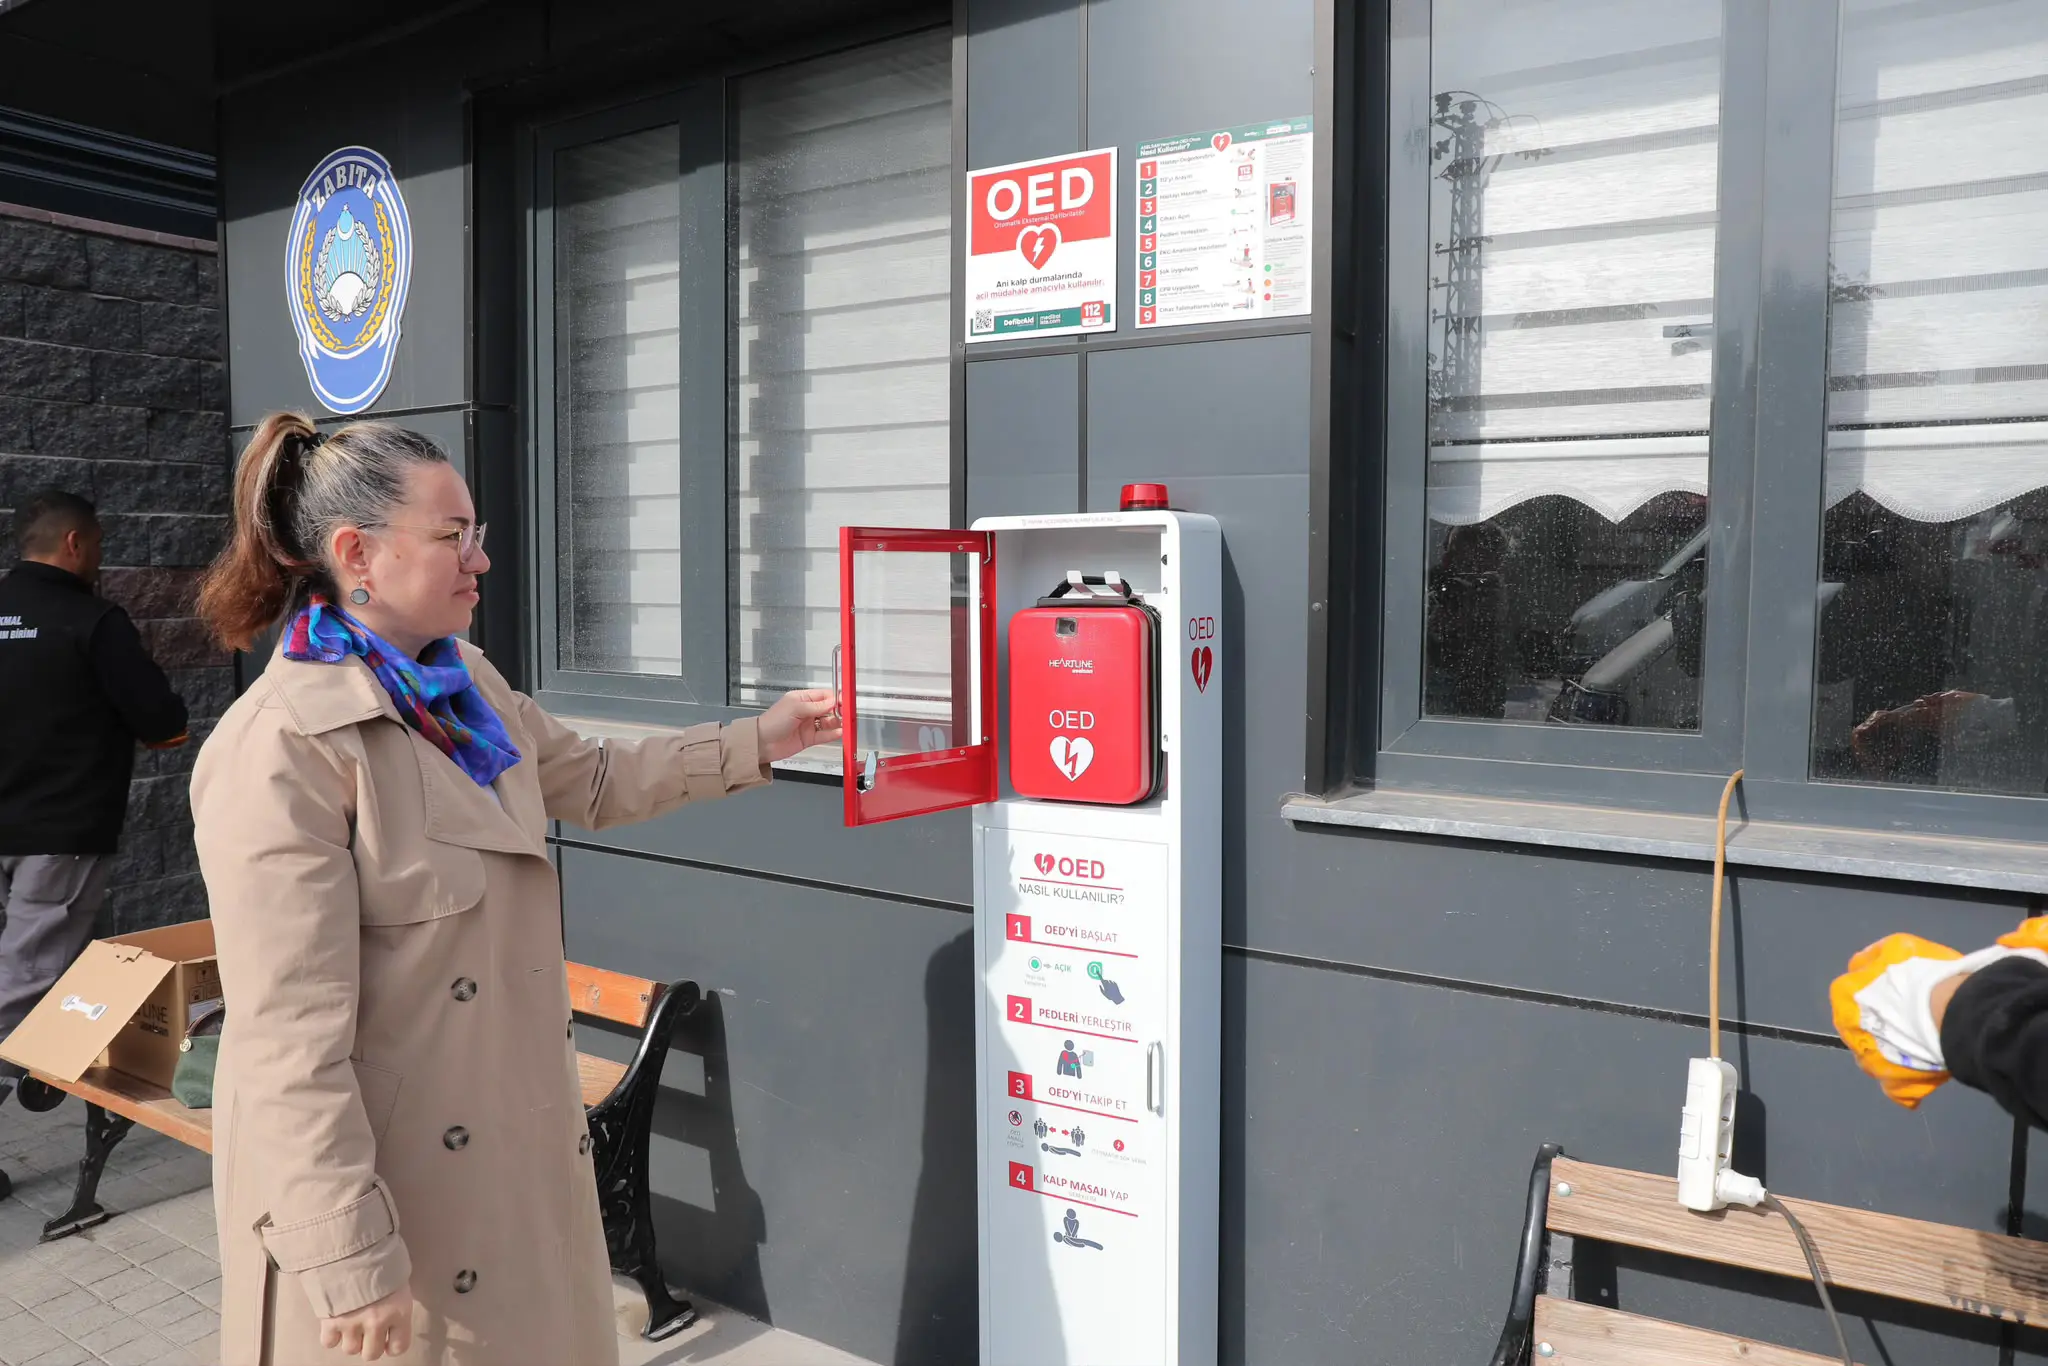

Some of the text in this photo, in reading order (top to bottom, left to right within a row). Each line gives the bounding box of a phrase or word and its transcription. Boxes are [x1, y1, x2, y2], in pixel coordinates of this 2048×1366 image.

[1145, 165, 1152, 176] 1
[312, 163, 377, 212] ZABITA
[986, 167, 1095, 221] OED
[1145, 183, 1153, 195] 2
[1145, 201, 1153, 213] 3
[1144, 219, 1153, 231] 4
[1145, 237, 1153, 249] 5
[1144, 256, 1153, 268] 6
[996, 271, 1083, 288] Ani kalp durmalarında
[1144, 274, 1152, 287] 7
[976, 290, 989, 301] acil
[1030, 282, 1066, 294] amacıyla
[1143, 293, 1152, 304] 8
[1084, 303, 1101, 317] 112
[1143, 310, 1152, 322] 9
[10, 627, 38, 639] BİRİMİ
[1188, 616, 1214, 641] OED
[1049, 657, 1093, 669] HEARTLINE
[1049, 709, 1095, 730] OED
[1058, 856, 1105, 880] OED
[1018, 883, 1125, 905] NASIL KULLANILIR?
[1014, 920, 1118, 944] 1 OED'Yİ BAŞLAT
[1054, 963, 1072, 973] AÇIK
[1014, 1002, 1132, 1033] 2 PEDLERİ YERLEŞTİR
[1015, 1079, 1127, 1110] 3 OED'Yİ TAKİP ET
[1016, 1169, 1129, 1201] 4 KALP MASAJI YAP
